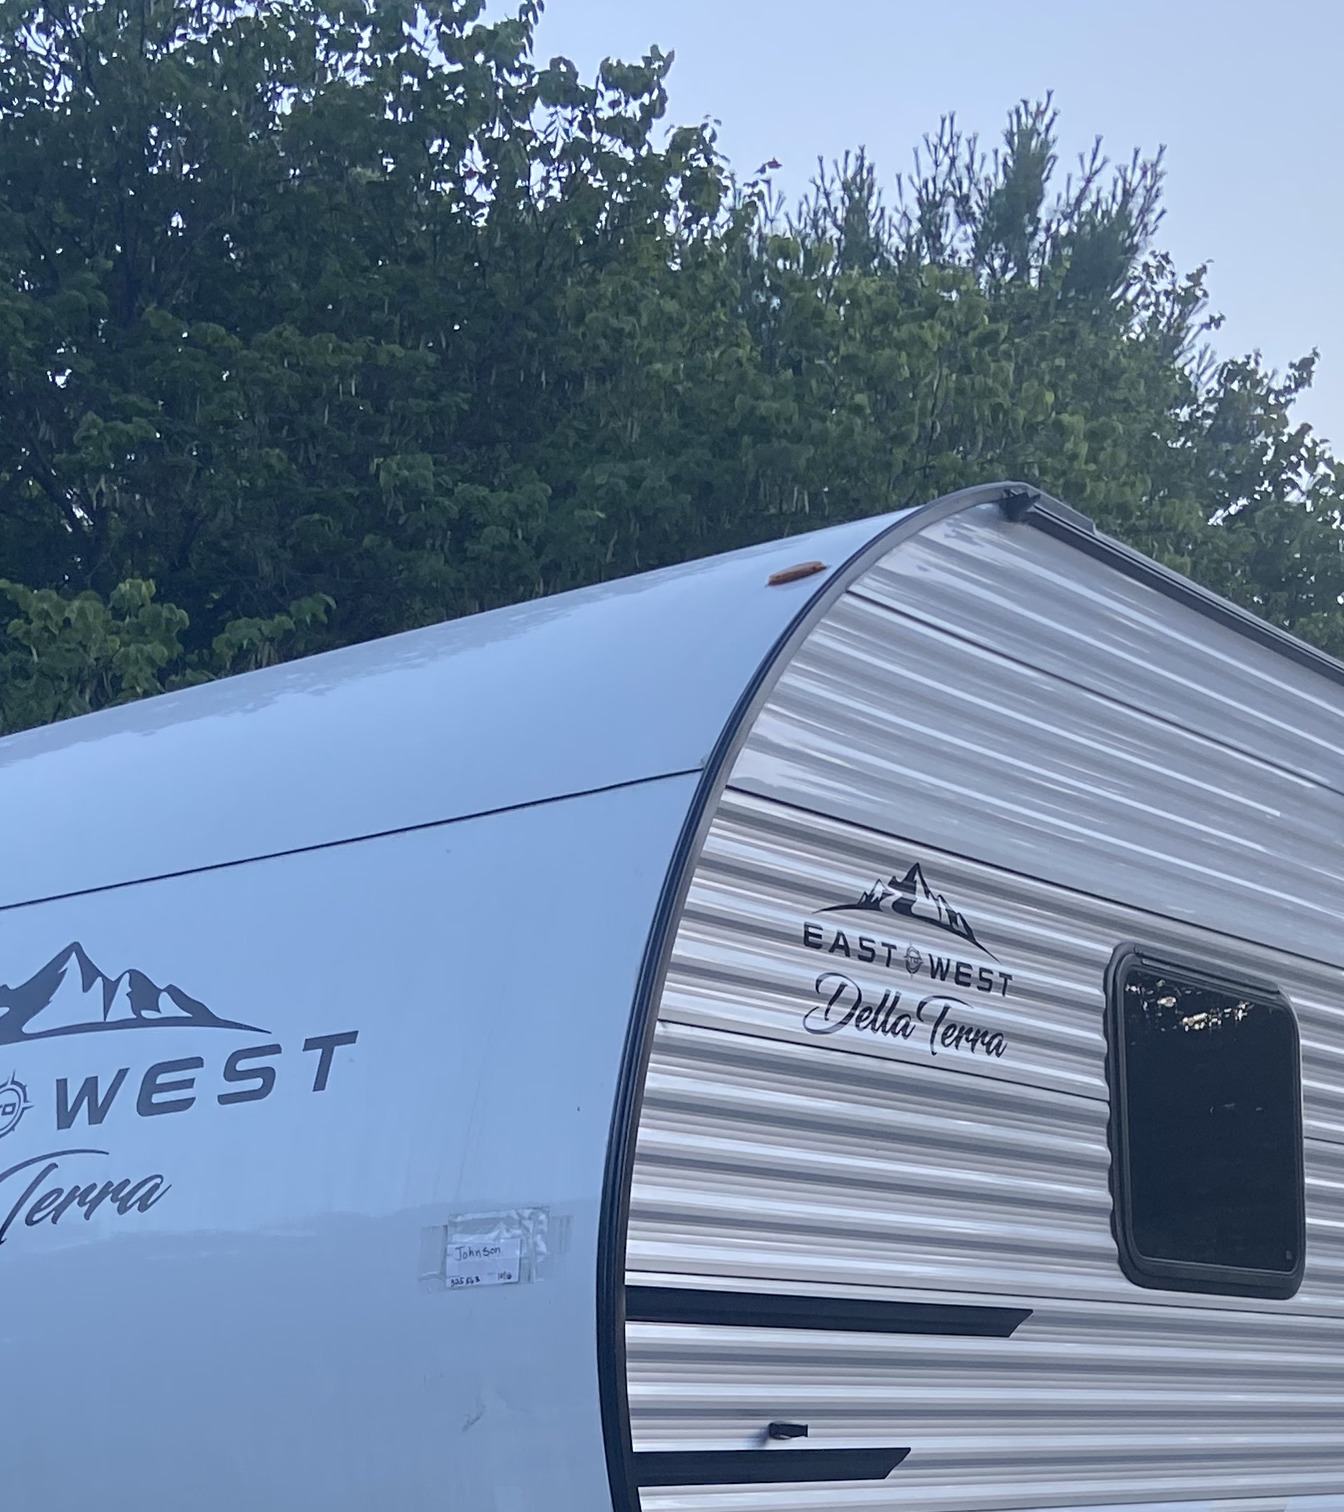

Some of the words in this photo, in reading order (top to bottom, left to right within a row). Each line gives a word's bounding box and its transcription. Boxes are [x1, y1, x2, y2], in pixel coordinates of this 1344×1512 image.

[802, 921, 898, 968] EAST
[927, 952, 1014, 998] WEST
[802, 971, 917, 1042] Della
[915, 994, 1009, 1059] Terra
[55, 1029, 360, 1131] WEST
